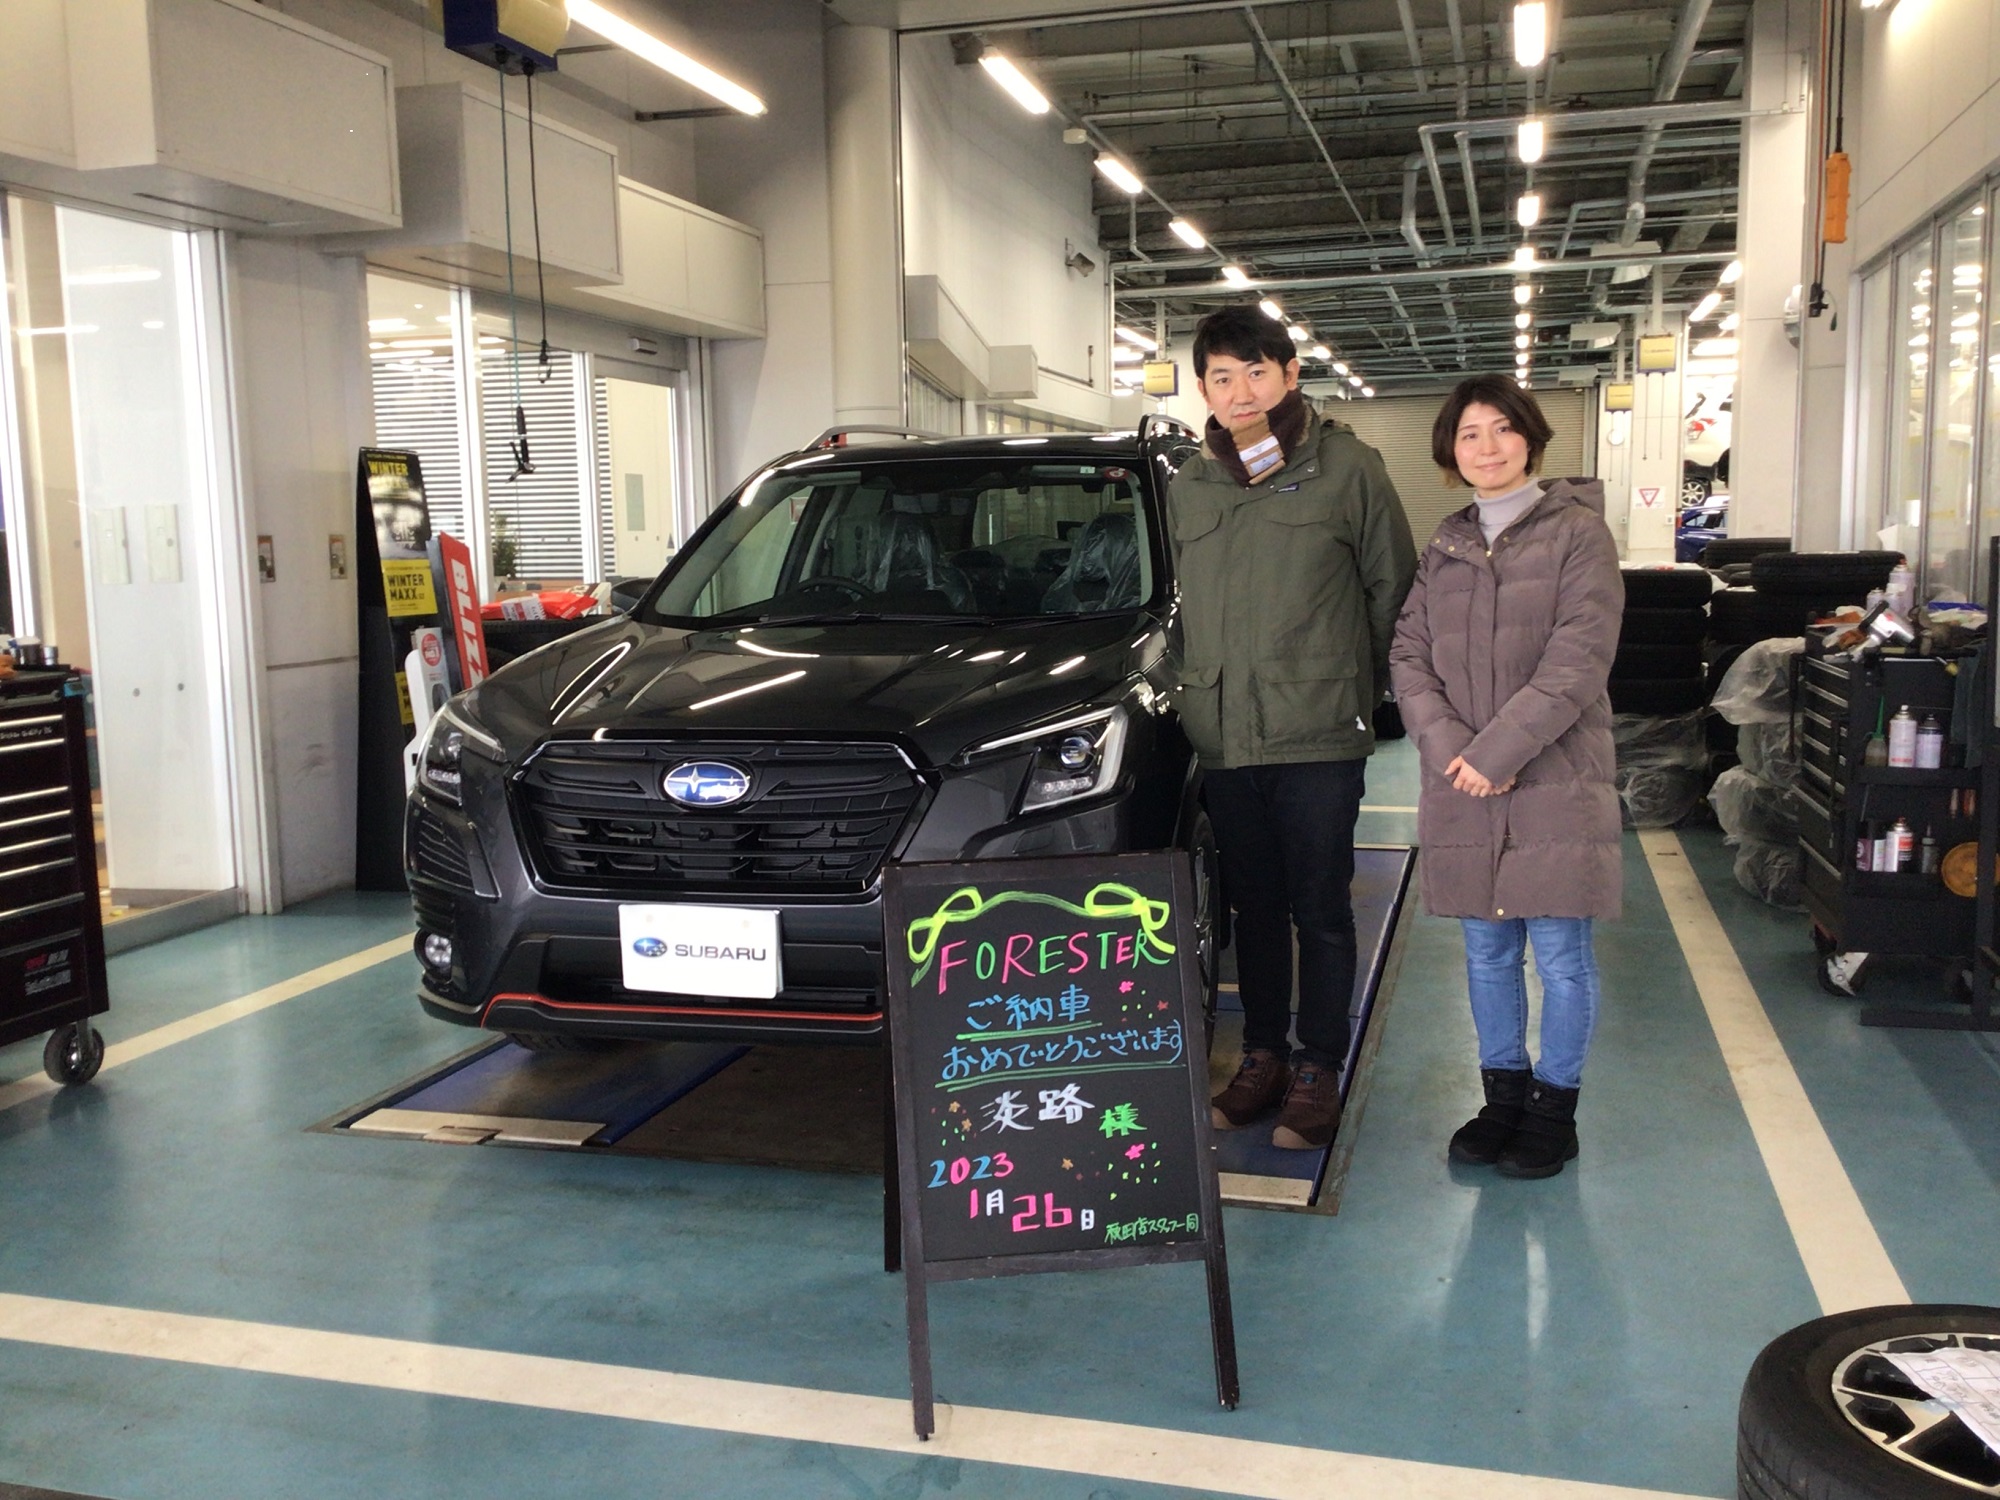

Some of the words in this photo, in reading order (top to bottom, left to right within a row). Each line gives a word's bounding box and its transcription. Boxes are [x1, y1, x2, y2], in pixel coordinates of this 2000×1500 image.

[387, 573, 425, 587] WINTER
[389, 587, 417, 600] MAXX
[674, 944, 767, 961] SUBARU
[938, 928, 1171, 995] FORESTER
[966, 983, 1091, 1031] ご納車
[941, 1018, 1183, 1080] おめでとうございます
[927, 1151, 1015, 1189] 2023
